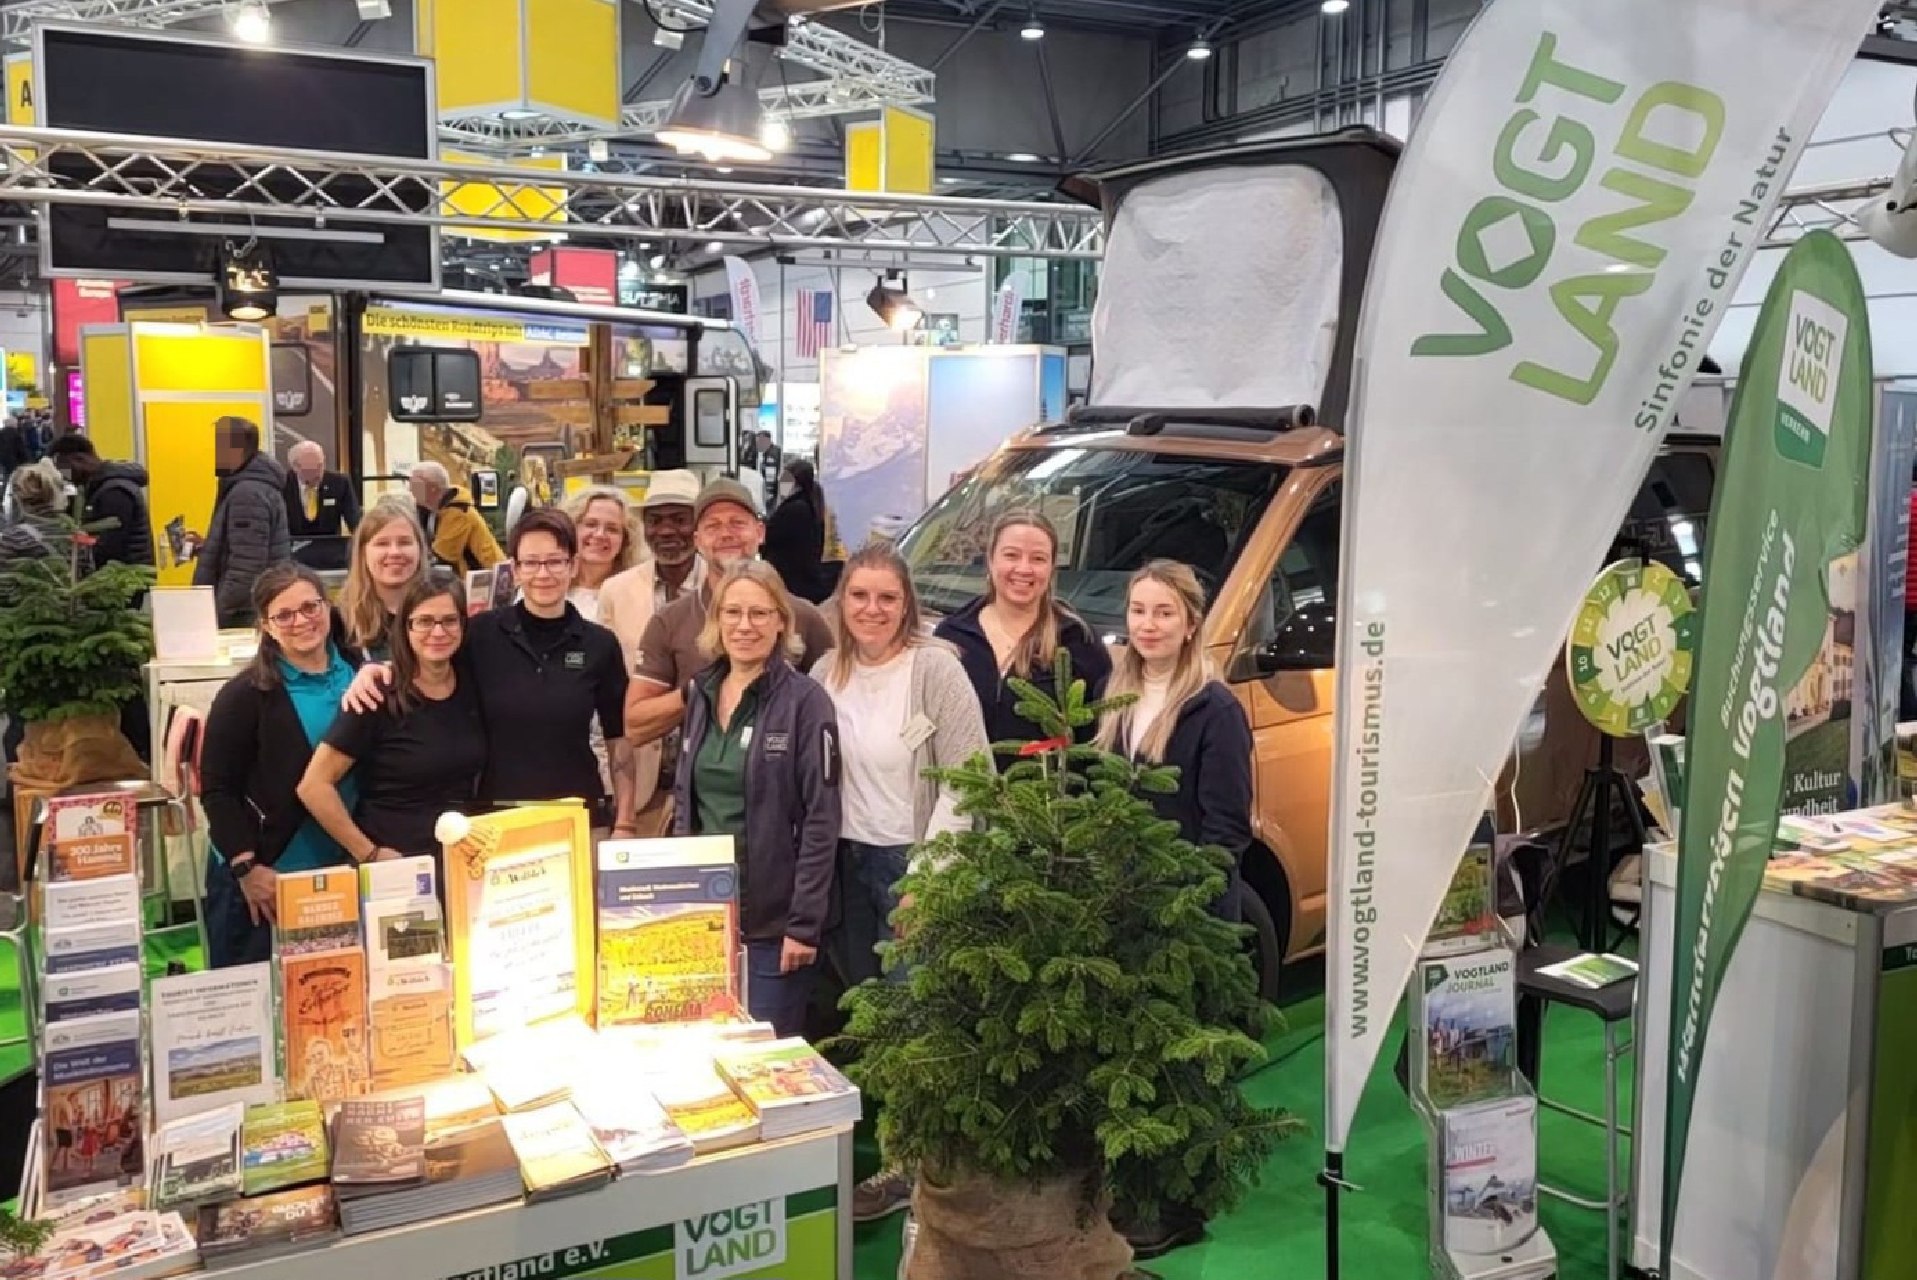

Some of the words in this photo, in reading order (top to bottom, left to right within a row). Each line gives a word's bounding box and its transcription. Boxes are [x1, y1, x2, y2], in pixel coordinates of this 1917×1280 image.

[1410, 31, 1628, 357] VOGT
[1509, 80, 1726, 406] LAND
[1635, 301, 1714, 432] Sinfonie
[1707, 228, 1744, 290] der
[1734, 126, 1793, 227] Natur
[1796, 314, 1836, 369] VOGT
[1790, 349, 1828, 404] LAND
[1607, 614, 1656, 661] VOGT
[1721, 508, 1779, 730] Buchungsservice
[1732, 528, 1795, 759] Vogtland
[1614, 636, 1662, 682] LAND
[1794, 769, 1841, 793] Kultur
[1350, 620, 1387, 1040] www.vogtland-tourismus.de
[1446, 978, 1496, 994] JOURNAL
[1454, 961, 1509, 980] VOGTLAND
[684, 1200, 776, 1244] VOGT
[564, 1238, 610, 1264] e.V.
[686, 1228, 777, 1275] LAND
